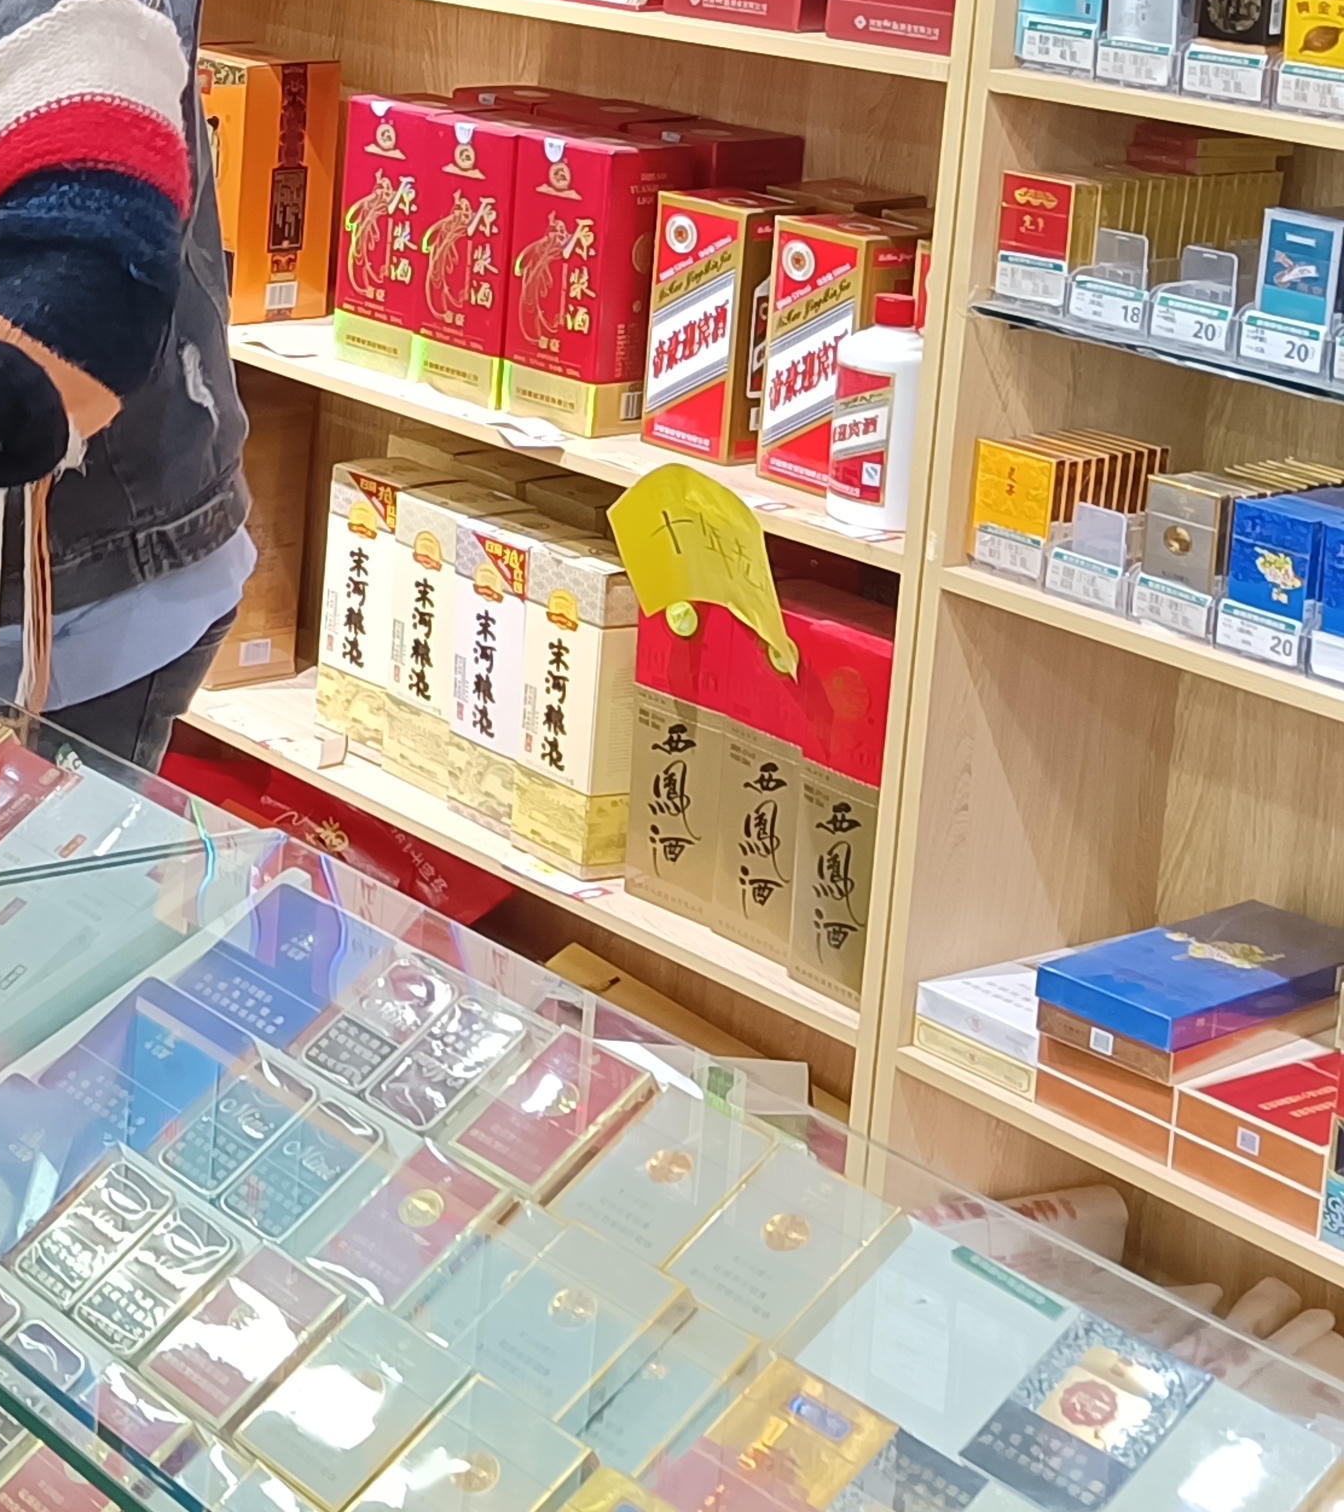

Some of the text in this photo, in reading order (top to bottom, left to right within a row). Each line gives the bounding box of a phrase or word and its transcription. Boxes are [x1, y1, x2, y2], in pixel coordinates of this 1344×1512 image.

[1121, 304, 1140, 324] 18
[340, 547, 370, 670] 宋河粮液
[407, 577, 436, 702] 宋河粮液
[1268, 635, 1293, 657] 20
[470, 609, 498, 739] 宋河粮液
[540, 637, 571, 774] 宋河粮液
